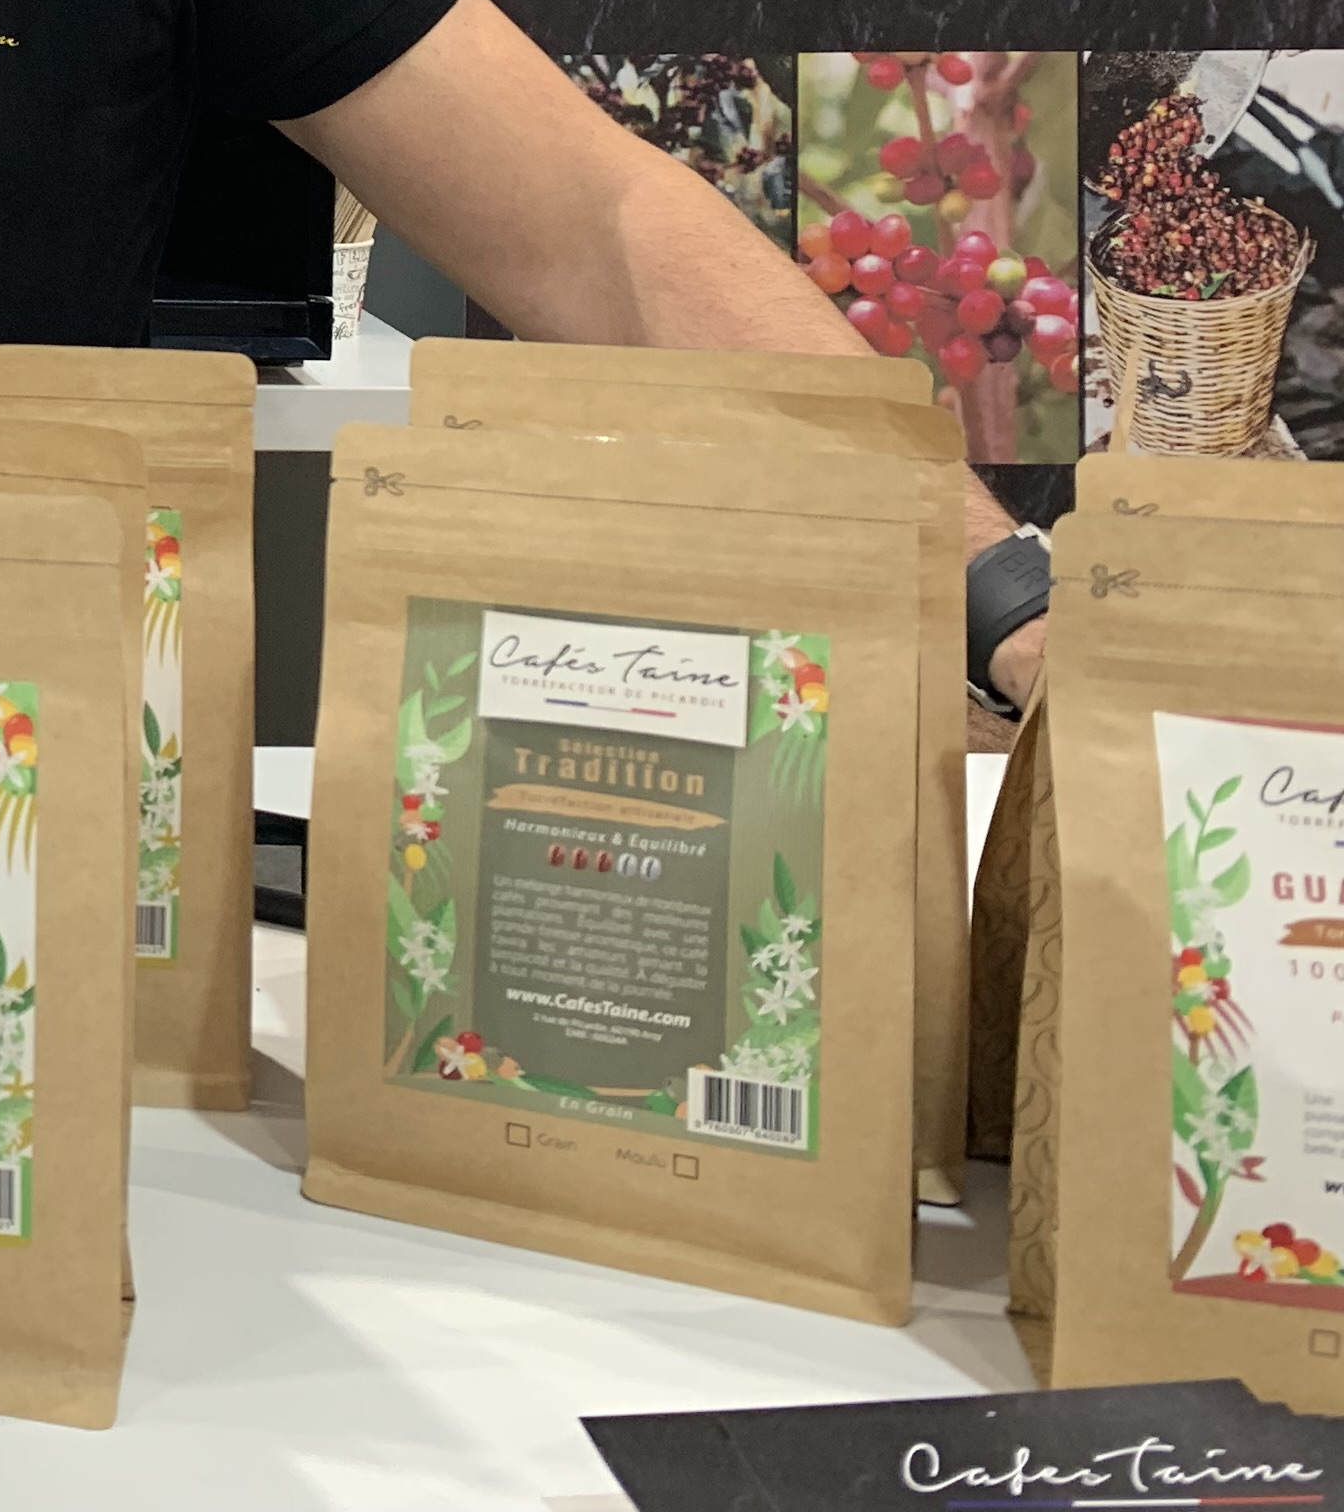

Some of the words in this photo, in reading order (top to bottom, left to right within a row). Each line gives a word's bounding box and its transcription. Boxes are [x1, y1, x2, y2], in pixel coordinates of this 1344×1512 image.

[488, 634, 606, 676] Cafés
[613, 644, 739, 688] Taine
[624, 688, 643, 700] DE
[514, 747, 704, 796] Tradition
[504, 818, 607, 844] Harmonieux
[612, 832, 621, 845] &
[506, 988, 691, 1028] www.CafesTaine.com
[560, 1097, 581, 1111] En
[585, 1099, 634, 1121] Grain
[536, 1133, 577, 1151] Grain
[902, 1442, 1112, 1495] Cafes
[1093, 1436, 1323, 1490] Taine
